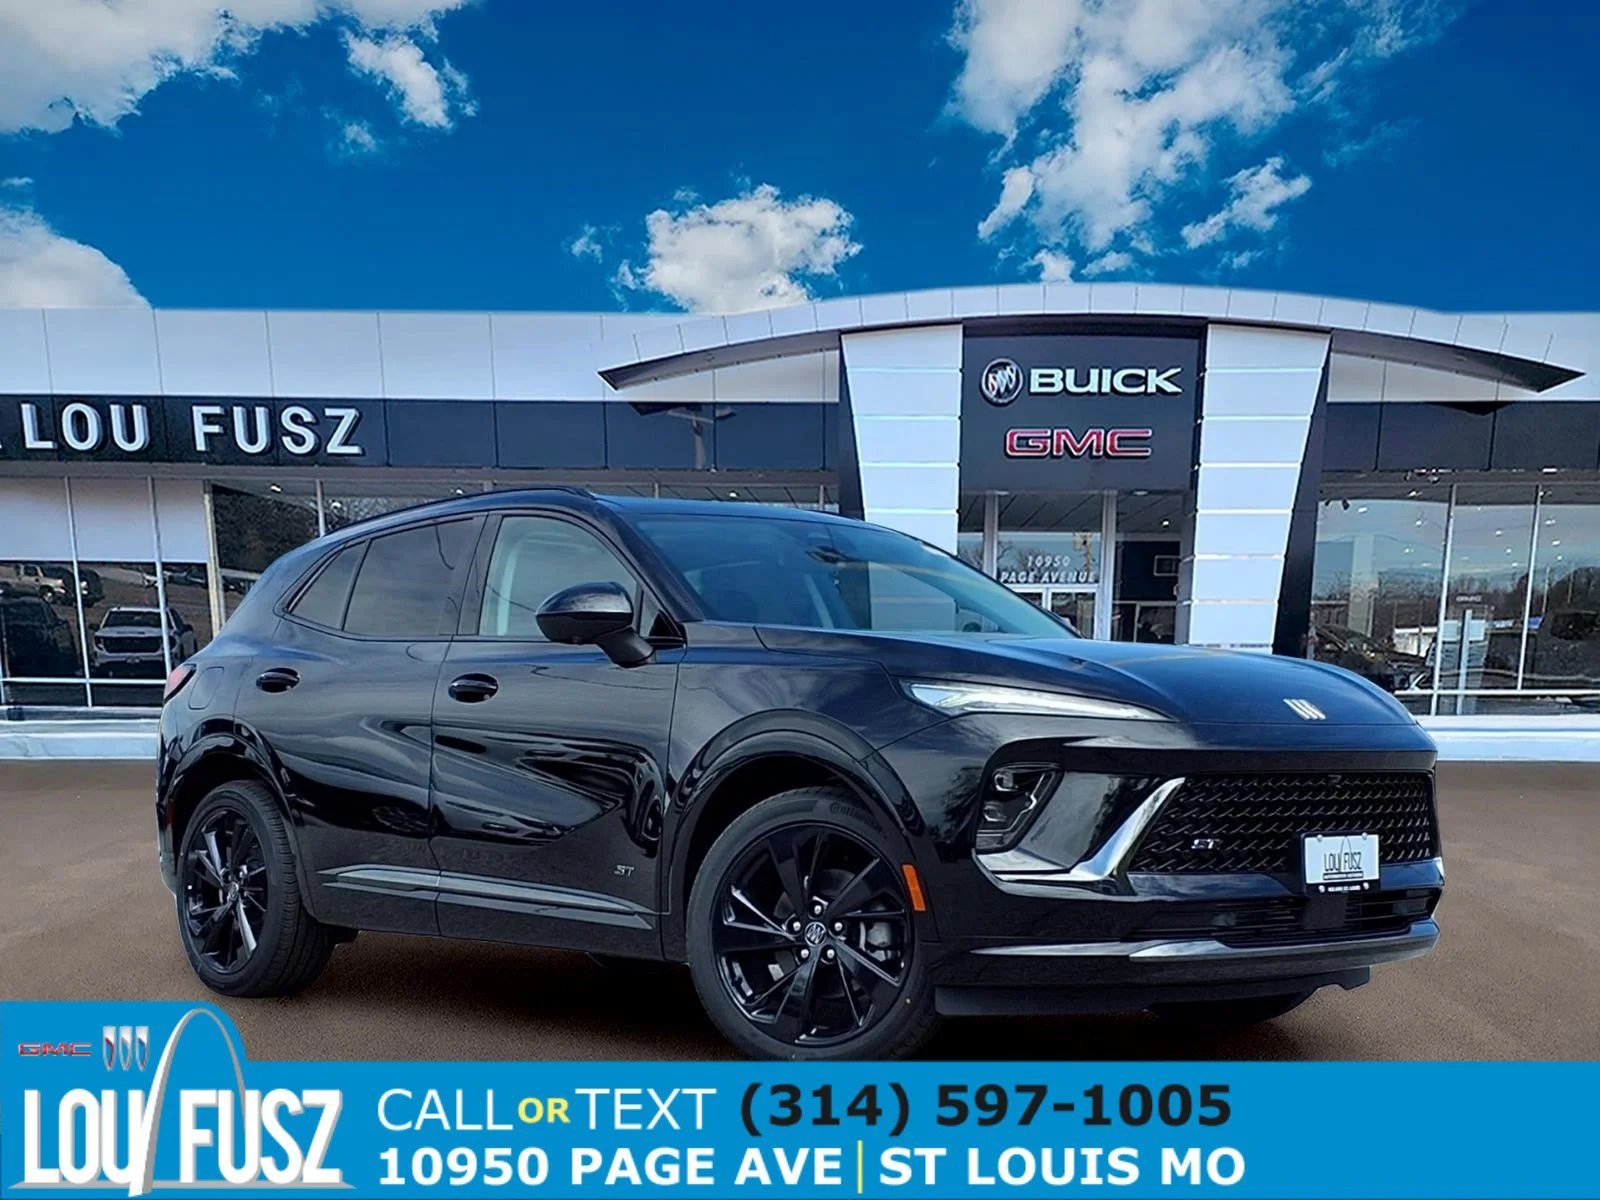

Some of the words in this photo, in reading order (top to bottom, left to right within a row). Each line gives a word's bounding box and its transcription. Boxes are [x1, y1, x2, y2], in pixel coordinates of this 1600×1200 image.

[1029, 367, 1182, 393] BUICK
[20, 402, 150, 451] LOU
[191, 404, 362, 455] FUSZ
[1006, 428, 1152, 456] GMC
[1027, 555, 1070, 567] 10950
[1000, 571, 1034, 583] PAGE
[1040, 571, 1095, 583] AVENUE
[614, 864, 635, 877] ST
[1323, 853, 1341, 871] LOU
[1344, 851, 1361, 870] FUSZ
